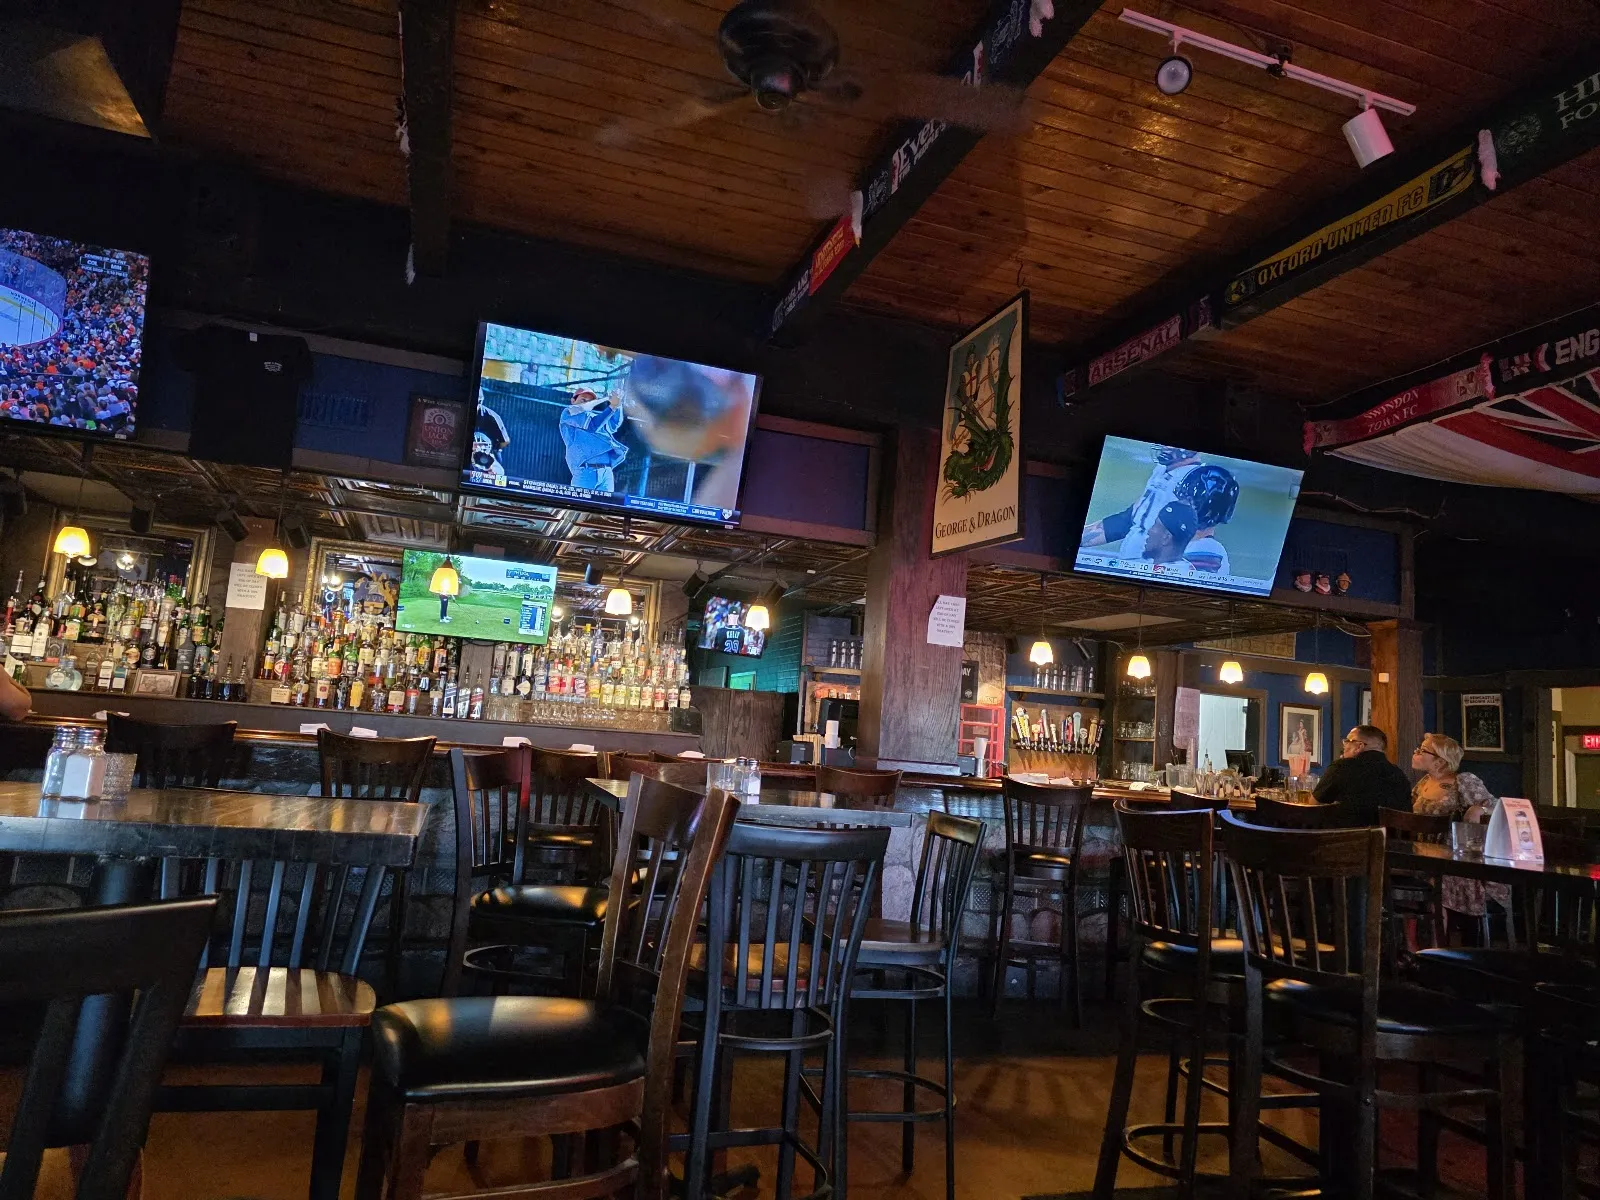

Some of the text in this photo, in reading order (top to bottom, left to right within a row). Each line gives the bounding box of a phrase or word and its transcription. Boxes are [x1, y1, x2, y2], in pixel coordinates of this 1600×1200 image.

[1560, 102, 1600, 130] FO
[1257, 186, 1424, 286] OXFORD UNITED FC
[1090, 321, 1180, 380] ARSENAL
[1555, 329, 1600, 365] ENG
[1363, 388, 1420, 420] SWINDON
[1367, 404, 1418, 433] TOWN FC
[424, 426, 454, 434] UNION
[428, 432, 448, 440] JACK
[935, 505, 1016, 539] GEORGE & DRAGON
[1585, 736, 1600, 748] EXI
